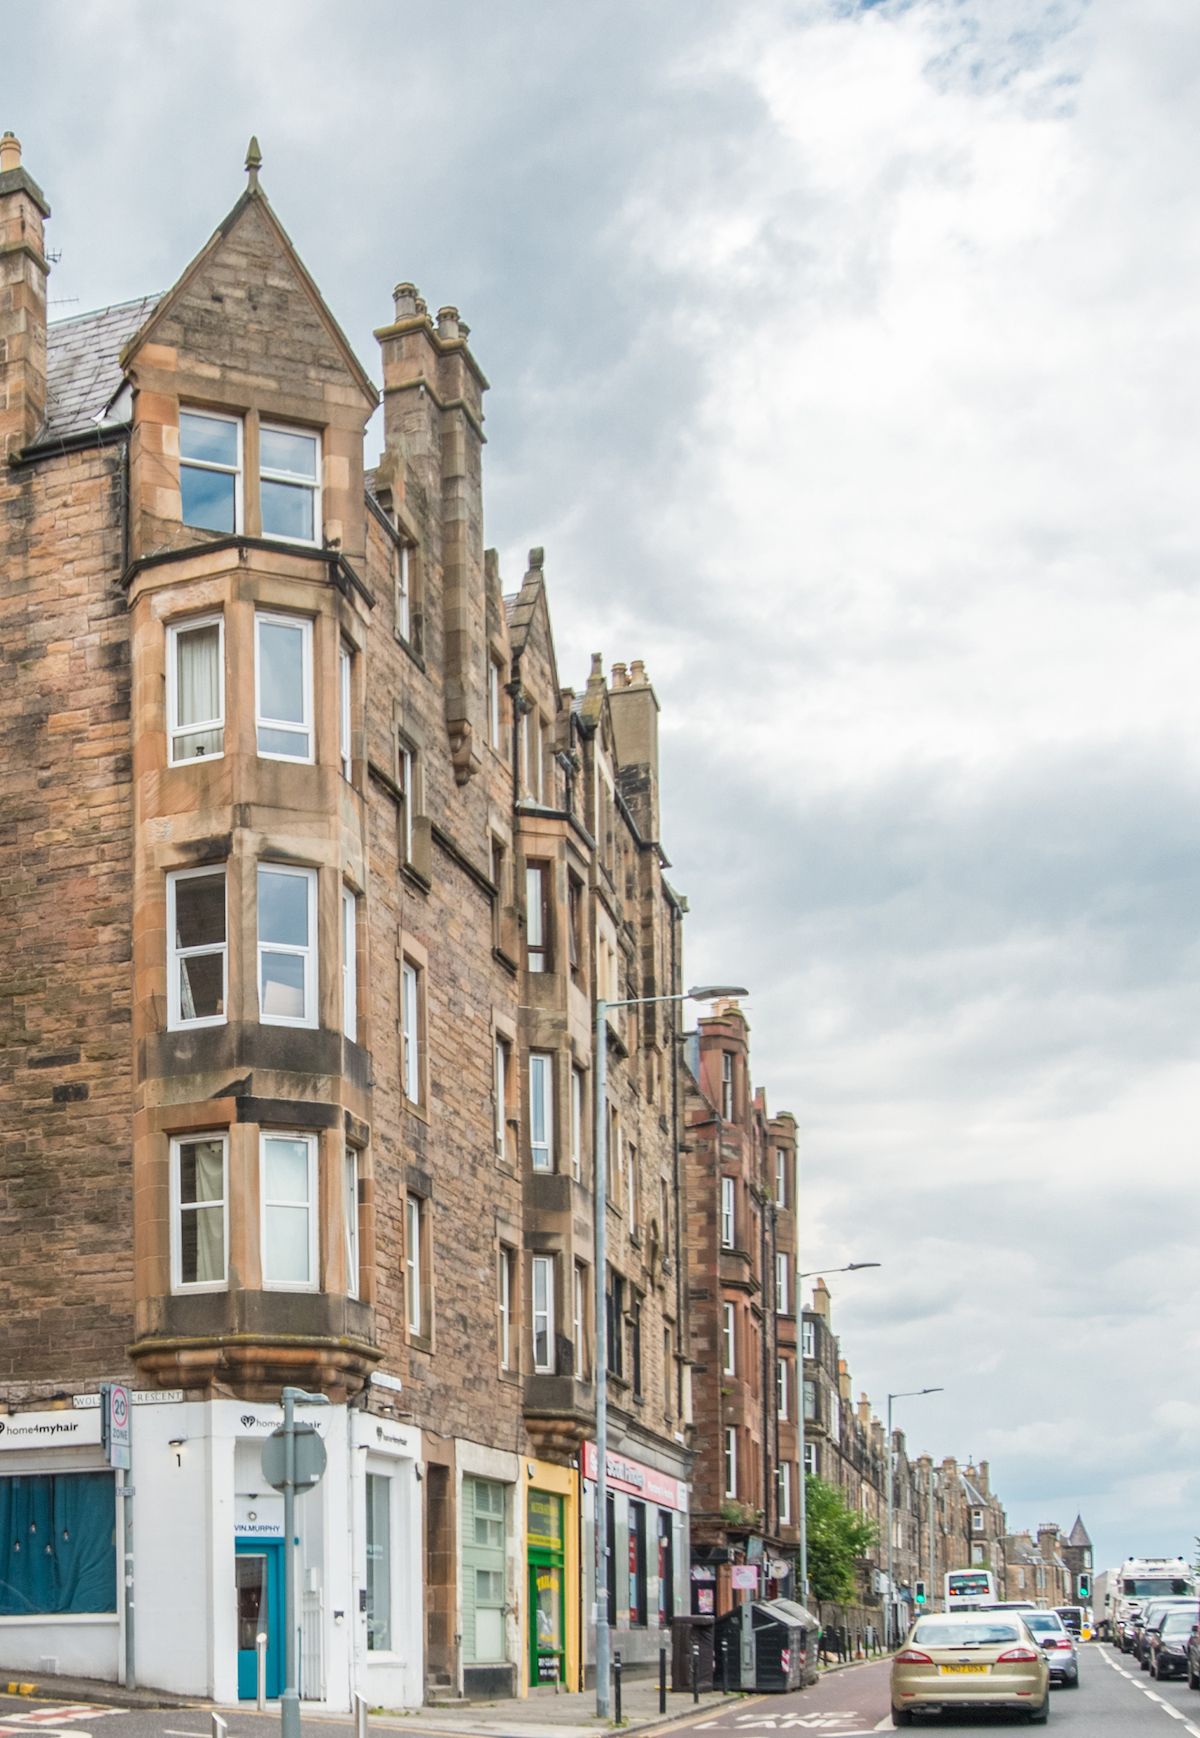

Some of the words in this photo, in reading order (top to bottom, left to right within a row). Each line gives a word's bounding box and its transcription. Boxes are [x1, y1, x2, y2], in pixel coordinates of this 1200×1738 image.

[115, 1399, 126, 1417] 20
[6, 1422, 79, 1436] home4myhair
[112, 1427, 128, 1440] ZONE
[693, 1718, 866, 1730] LANE
